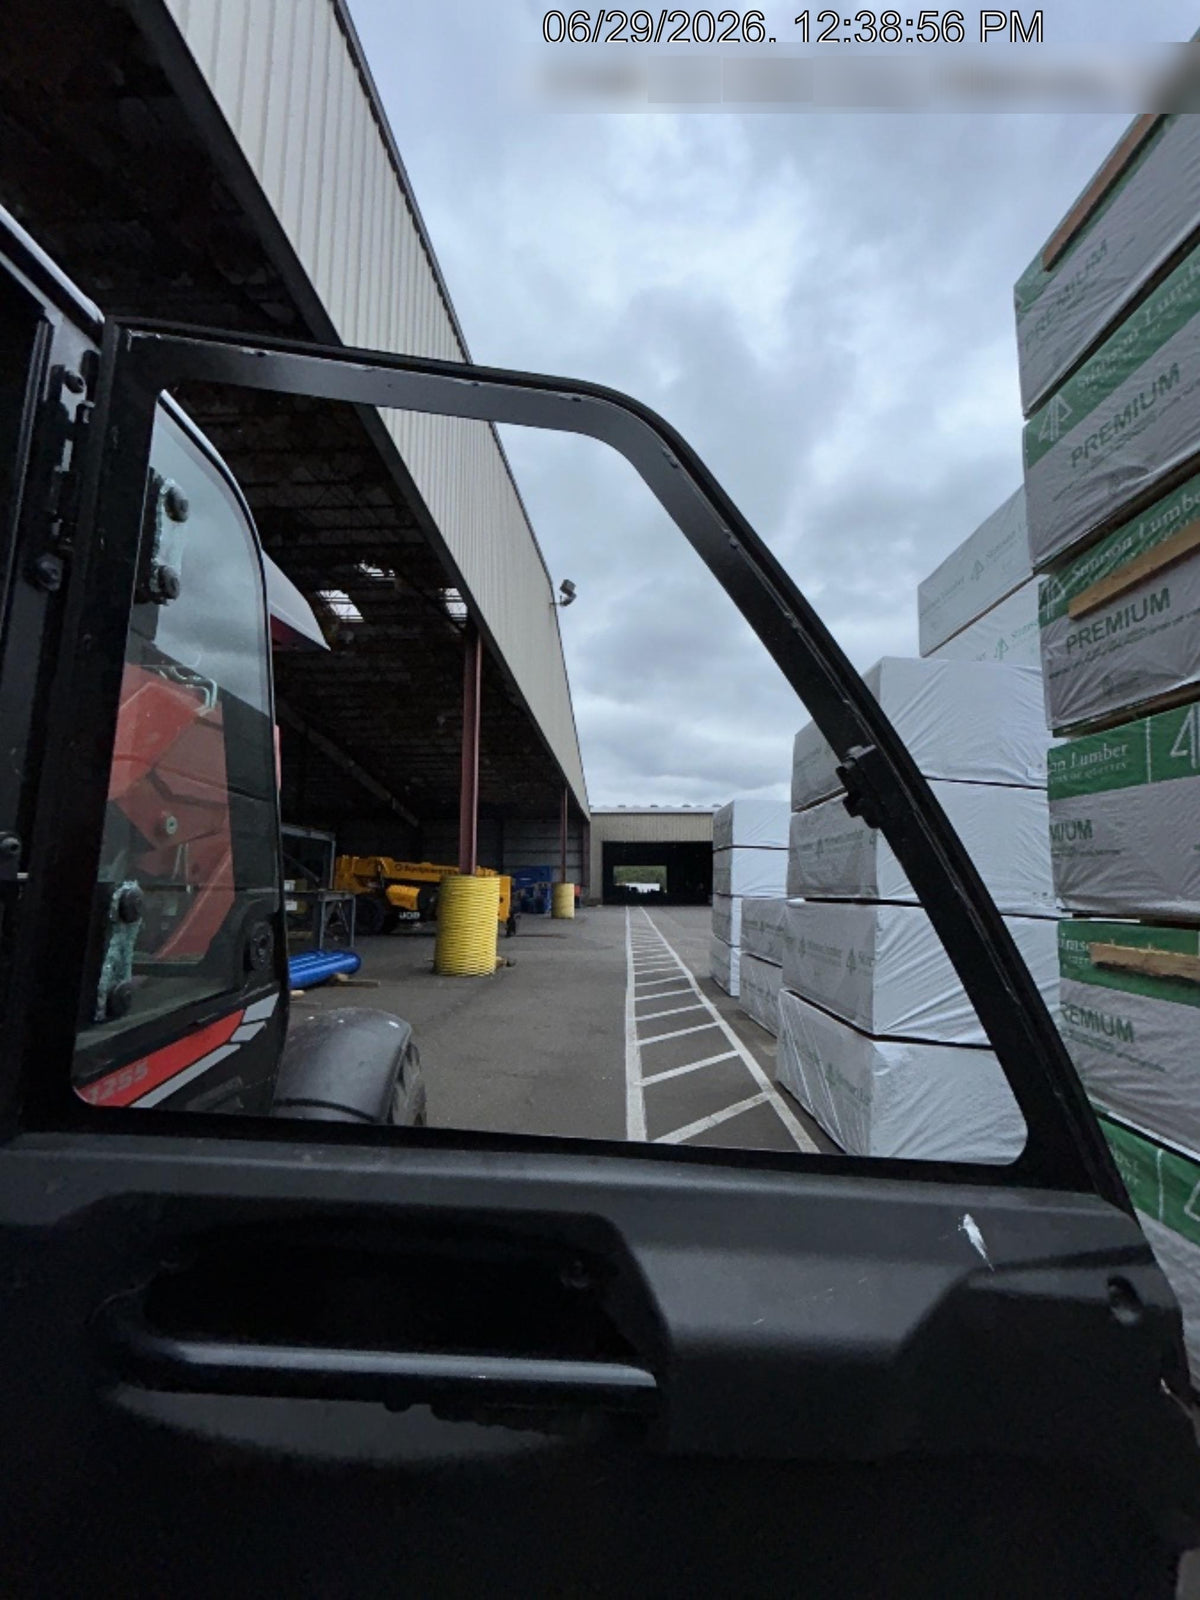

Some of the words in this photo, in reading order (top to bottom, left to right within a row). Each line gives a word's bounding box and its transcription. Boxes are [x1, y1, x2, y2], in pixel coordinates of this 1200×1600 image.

[1071, 361, 1180, 469] PREMIUM
[1065, 587, 1171, 656] PREMIUM
[1070, 742, 1129, 770] Lumber
